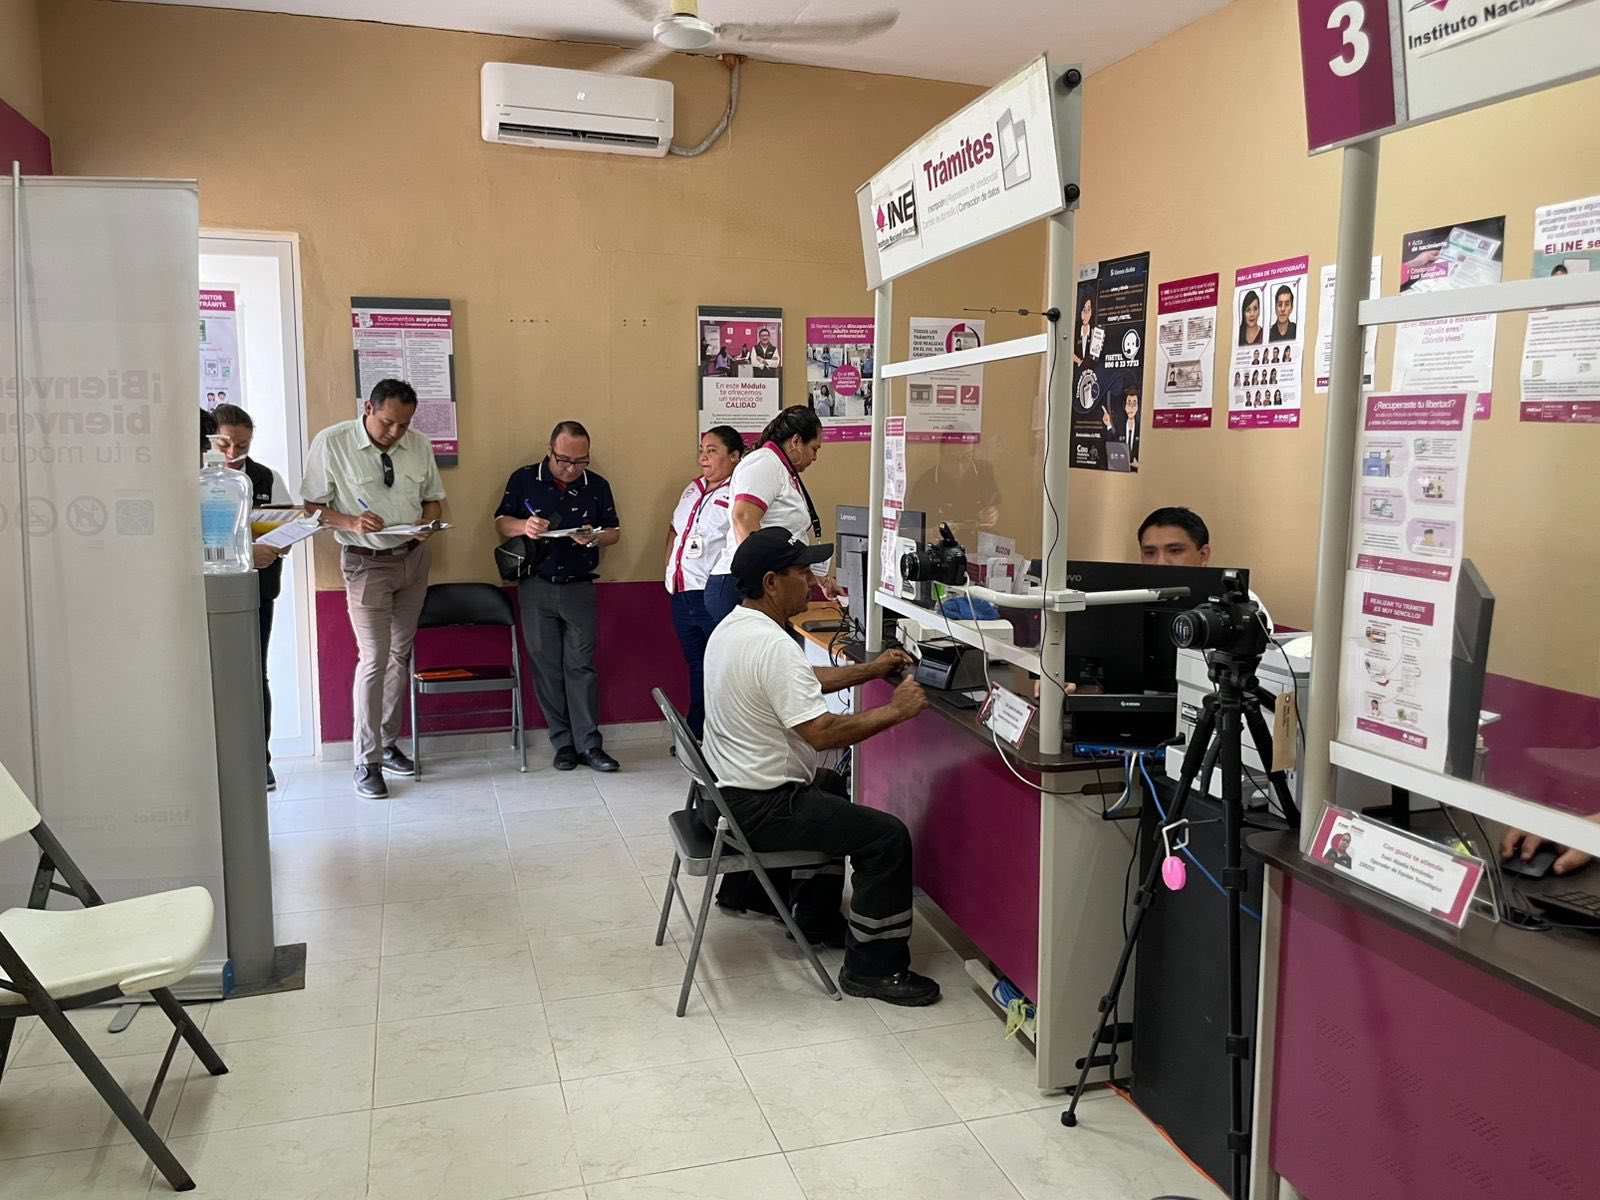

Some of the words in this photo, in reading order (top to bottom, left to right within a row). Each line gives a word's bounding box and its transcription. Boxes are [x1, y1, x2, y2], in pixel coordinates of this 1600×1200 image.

[1408, 15, 1478, 50] Instituto
[1483, 0, 1545, 22] Nacio
[1327, 0, 1369, 77] 3
[922, 132, 994, 192] Trámites
[887, 190, 914, 229] INE
[1418, 241, 1448, 251] nacimiento
[1545, 243, 1557, 255] El
[1560, 240, 1583, 253] INE
[200, 300, 228, 308] TRÁMITE
[377, 315, 415, 323] Documentos
[1445, 324, 1464, 333] eres?
[1374, 401, 1417, 411] ¿Recuperaste
[1425, 399, 1457, 409] libertad?
[840, 513, 857, 521] Lenovo
[1370, 597, 1394, 607] REALIZAR
[1382, 842, 1395, 852] Con
[1395, 848, 1412, 859] gusto
